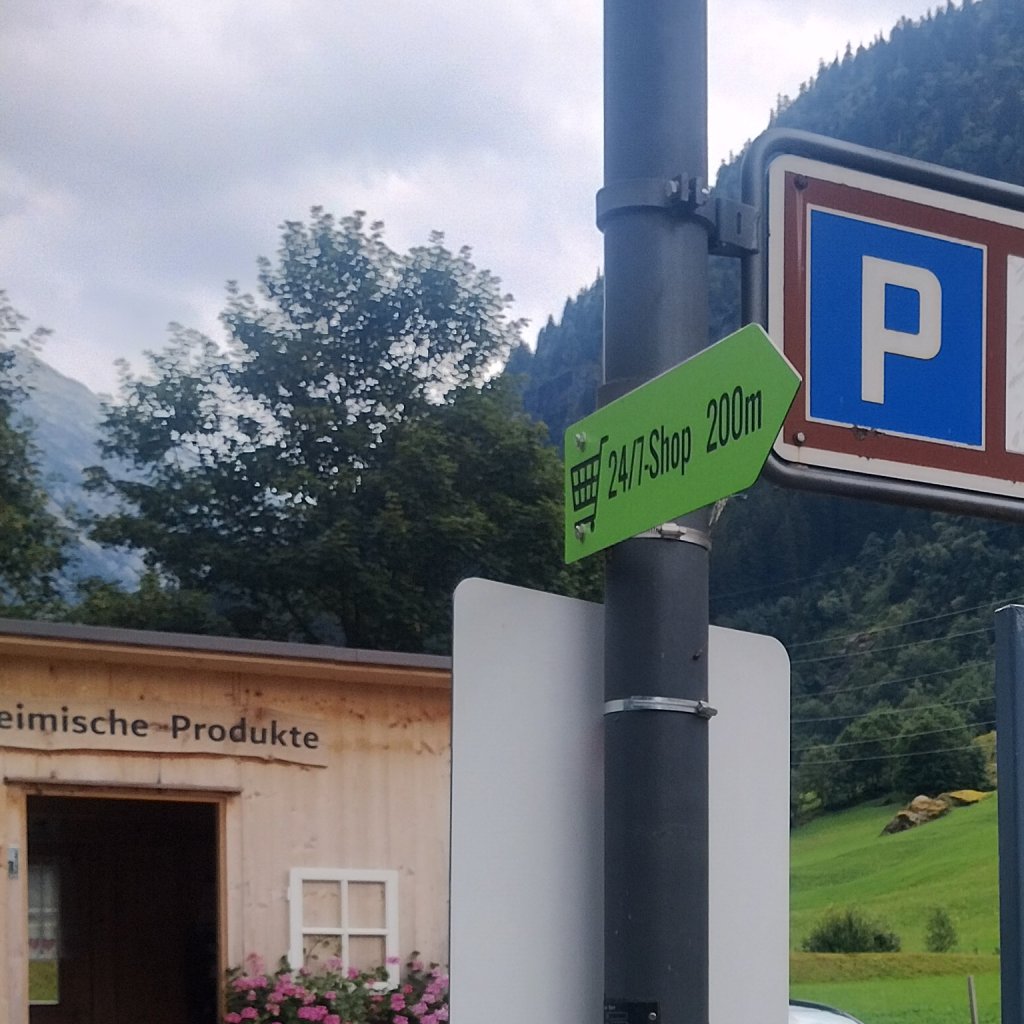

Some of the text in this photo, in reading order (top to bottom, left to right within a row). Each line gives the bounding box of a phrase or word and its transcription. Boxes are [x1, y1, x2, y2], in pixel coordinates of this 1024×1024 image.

[861, 254, 942, 404] P
[608, 385, 762, 500] 24/7-Shop 200m
[0, 702, 320, 750] eimische Produkte
